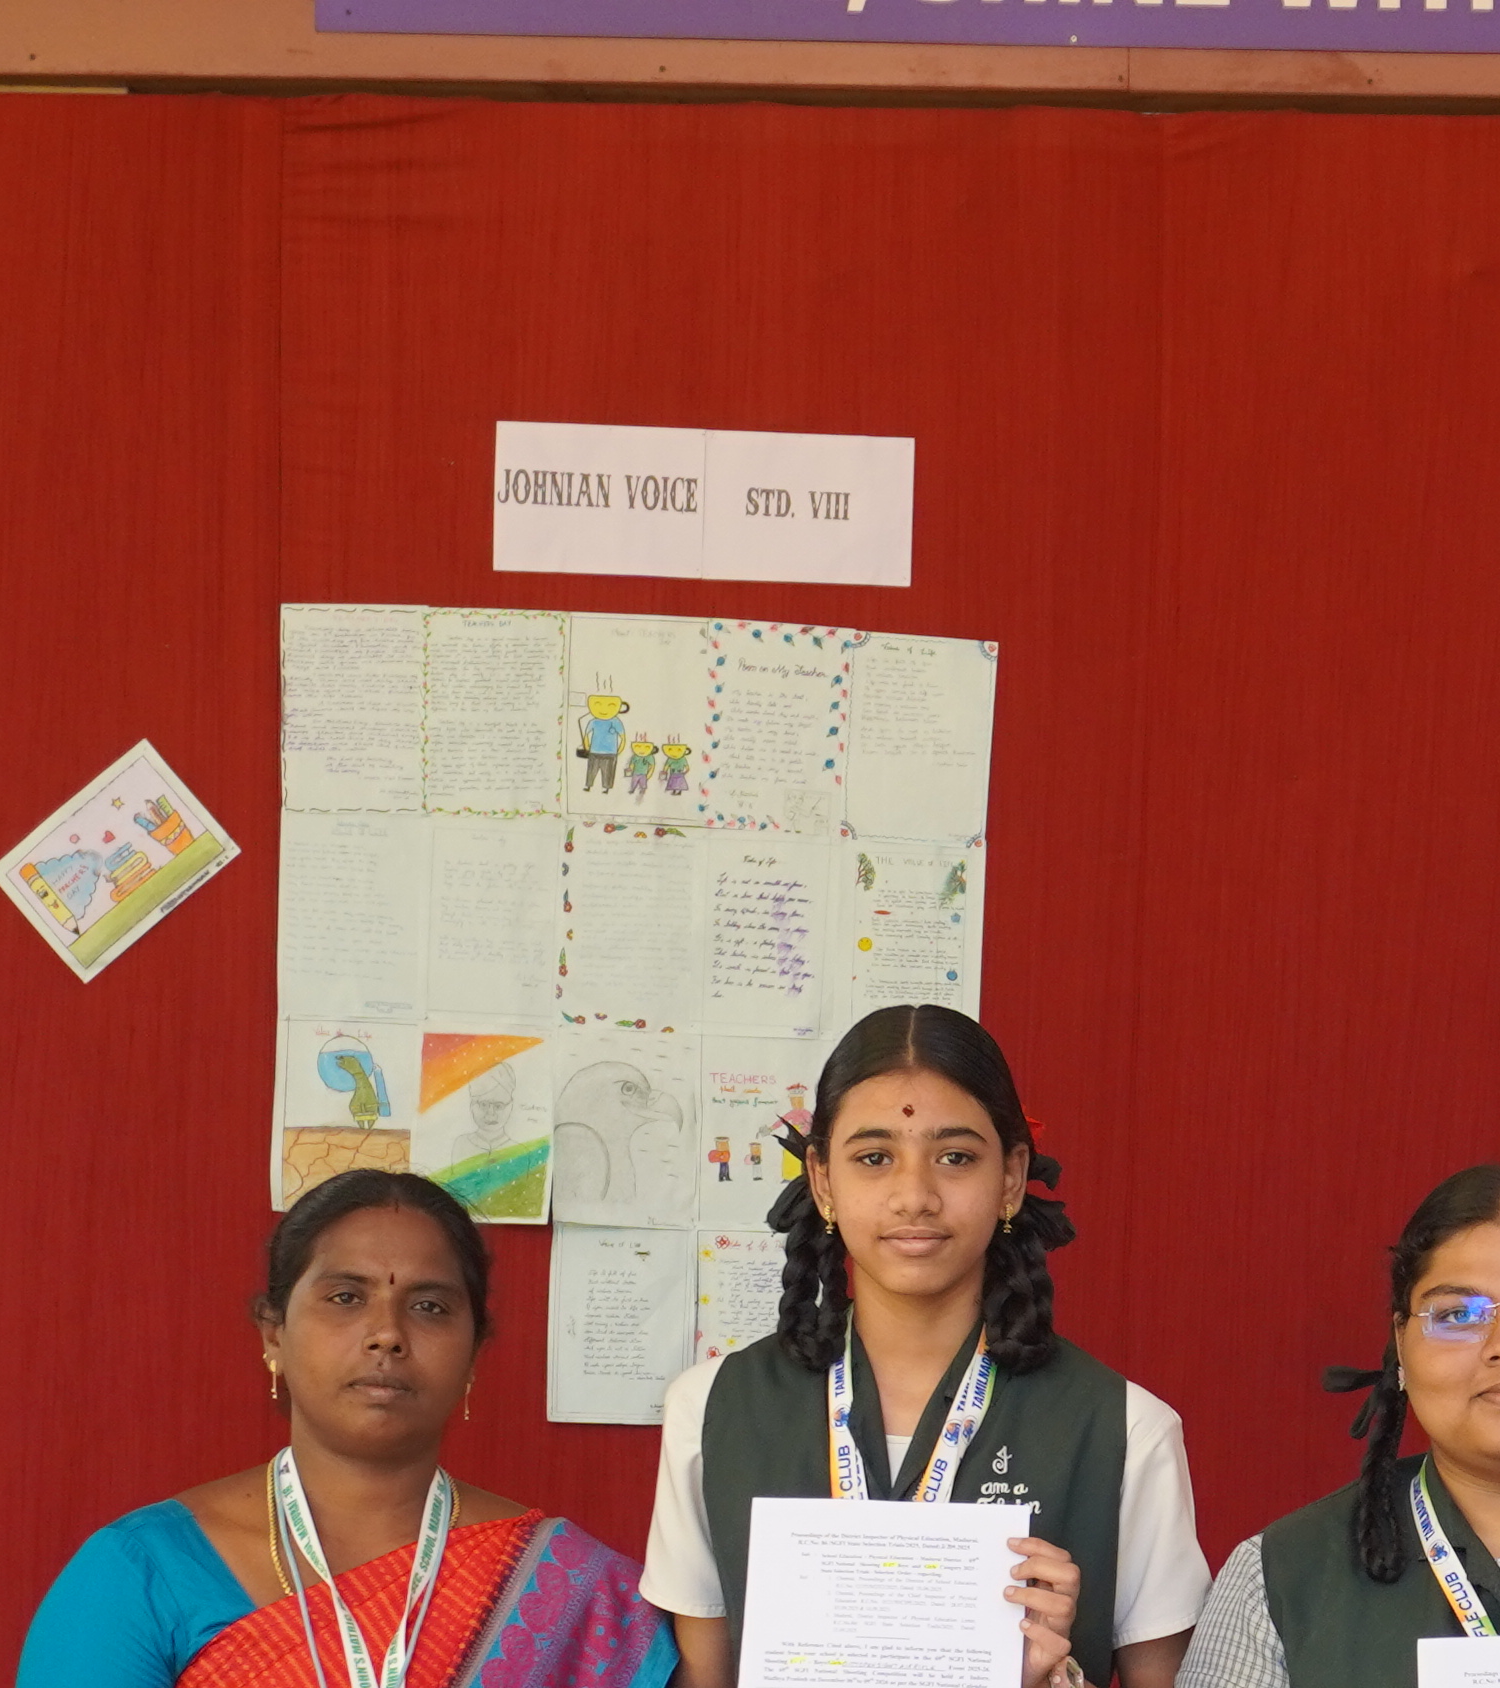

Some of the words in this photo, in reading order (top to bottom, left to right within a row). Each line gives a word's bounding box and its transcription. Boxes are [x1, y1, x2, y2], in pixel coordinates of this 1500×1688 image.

[497, 469, 611, 508] JOHNIAN
[624, 474, 698, 513] VOICE
[745, 487, 795, 519] STD.
[808, 490, 850, 520] VIII
[709, 1072, 777, 1085] TEACHERS
[971, 1352, 993, 1410] TAMILNAD
[837, 1445, 851, 1491] CLUB
[923, 1459, 948, 1503] CLUB
[981, 1482, 1010, 1495] am
[1013, 1484, 1028, 1495] a
[286, 1498, 311, 1542] MADURAI
[428, 1496, 443, 1534] MADURAI
[1445, 1571, 1472, 1610] CLUB
[1464, 1612, 1489, 1637] FLE
